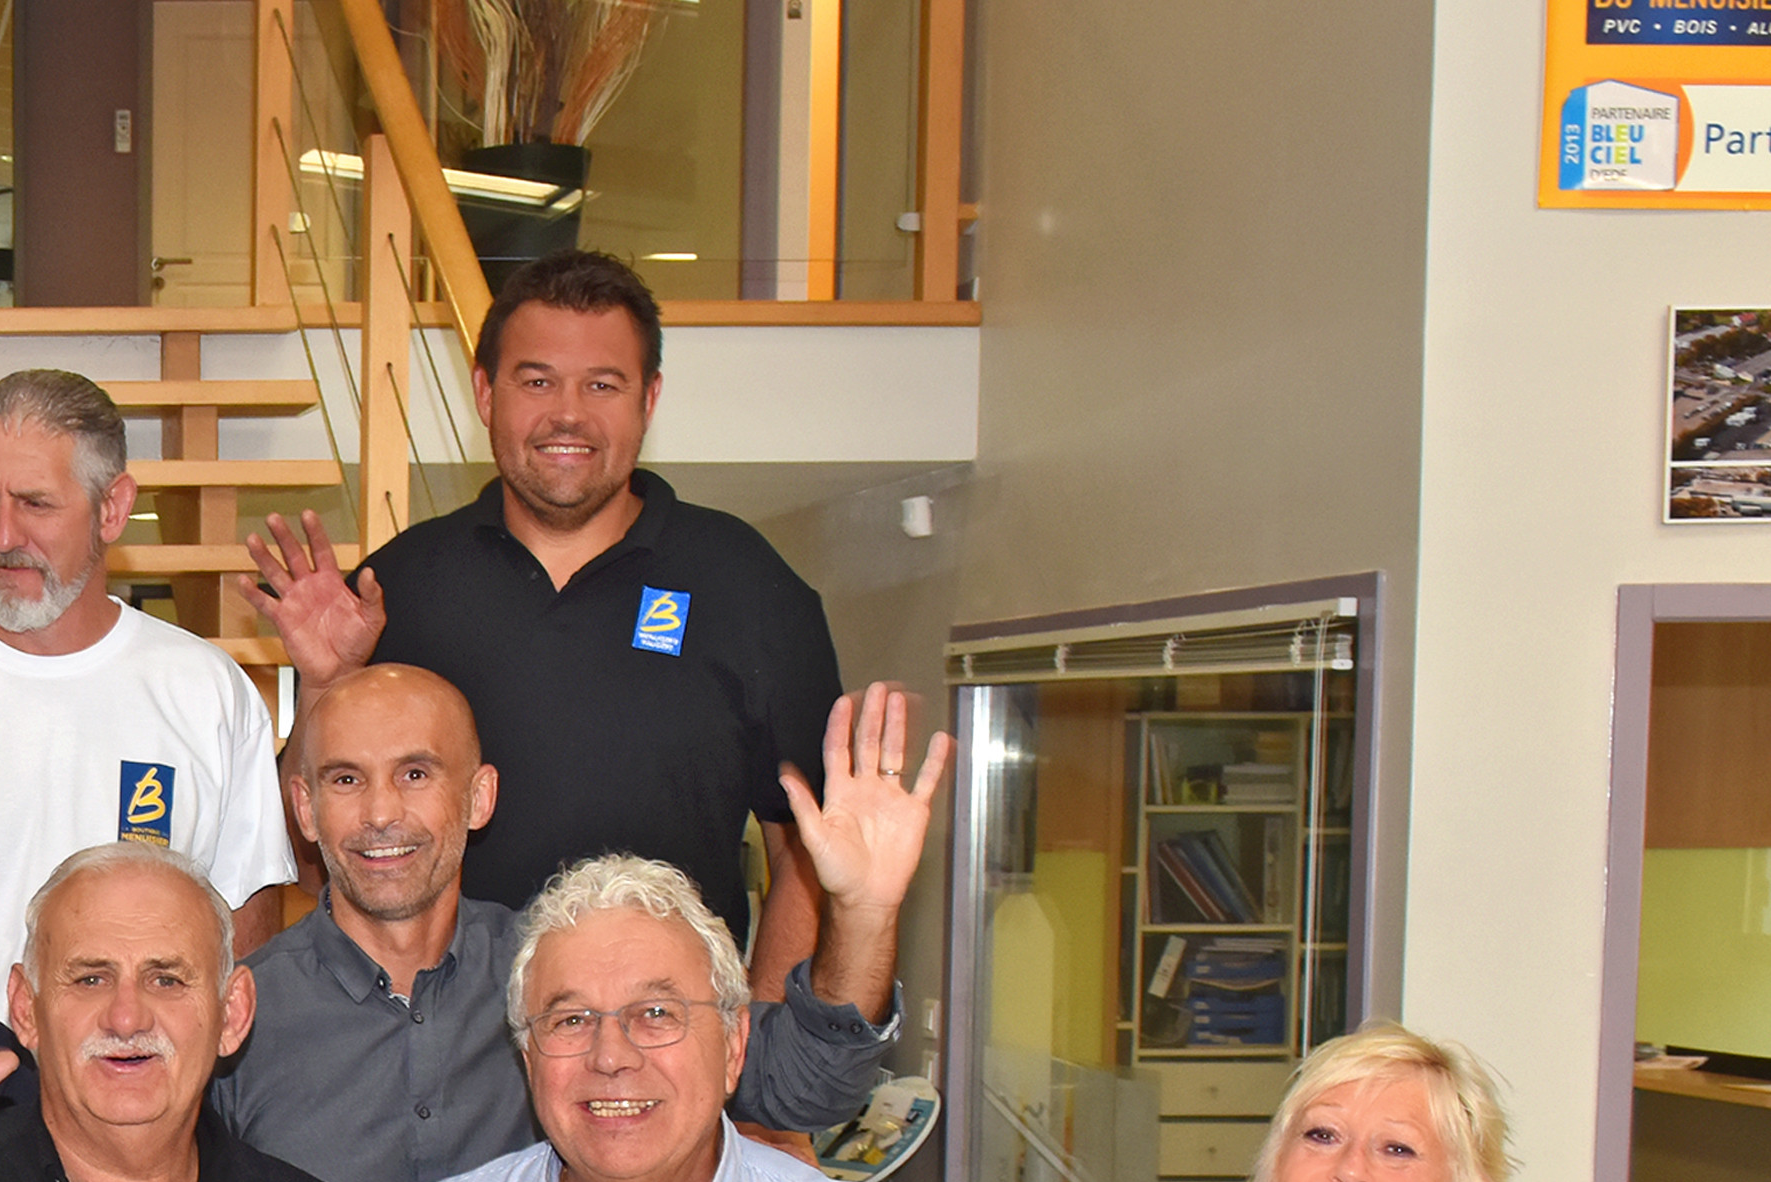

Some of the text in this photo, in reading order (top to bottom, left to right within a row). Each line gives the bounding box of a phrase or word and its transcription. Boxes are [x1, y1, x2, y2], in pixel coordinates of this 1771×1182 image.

[1603, 19, 1771, 35] PVC BOIS AL
[1591, 106, 1672, 120] PARTENAIRE
[1591, 124, 1645, 143] BLEU
[1564, 124, 1581, 164] 2013
[1590, 146, 1642, 165] CIEL
